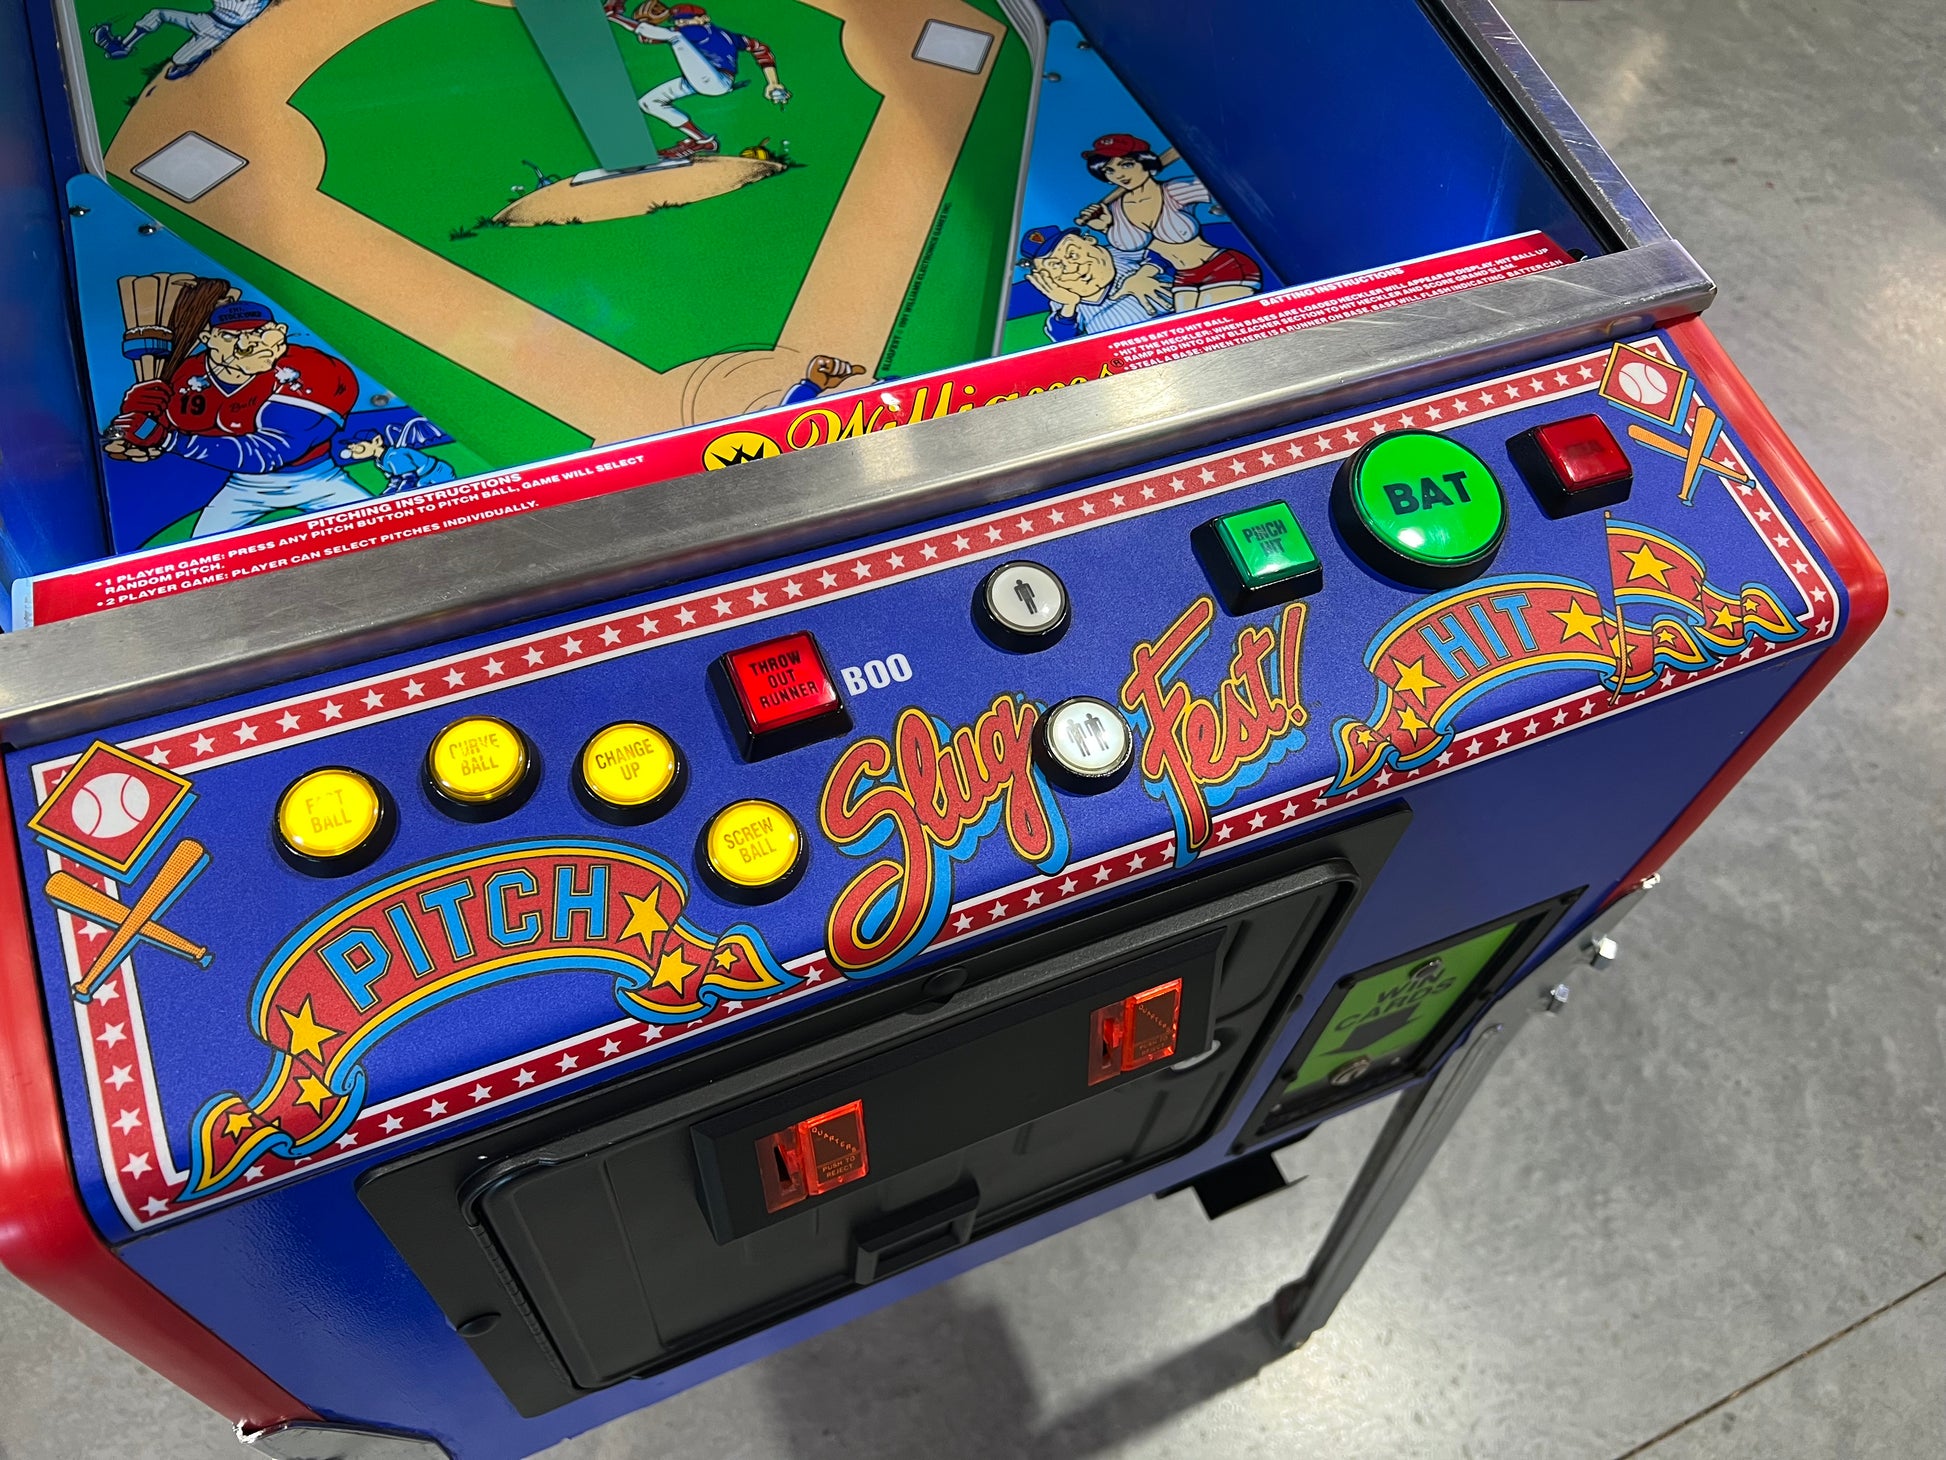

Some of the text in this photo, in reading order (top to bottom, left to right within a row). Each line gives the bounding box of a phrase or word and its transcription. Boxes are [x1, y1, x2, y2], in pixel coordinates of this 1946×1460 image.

[1119, 347, 1138, 356] HIT
[1138, 341, 1159, 352] THE
[1160, 330, 1213, 348] HECKLER:
[1212, 323, 1244, 335] WHEN
[1244, 315, 1277, 329] BASES
[1277, 309, 1298, 319] ARE
[1298, 299, 1338, 314] LOADED
[1339, 289, 1383, 304] HECKLER
[1383, 284, 1407, 294] WILL
[1407, 274, 1445, 288] APPEAR
[1444, 271, 1456, 281] IN
[1495, 257, 1512, 267] HIT
[1512, 251, 1536, 263] BALL
[1535, 247, 1549, 256] UP
[1259, 267, 1405, 307] BATTING INSTRUCTIONS
[1124, 351, 1155, 363] RAMP
[1156, 346, 1179, 356] AND
[1179, 339, 1205, 350] INTO
[1205, 334, 1227, 345] ANY
[1227, 320, 1279, 340] BLEACHER
[1278, 311, 1319, 327] SECTION
[1321, 306, 1338, 315] TO
[1339, 301, 1357, 310] HIT
[1356, 290, 1400, 305] HECKLER
[1400, 286, 1424, 296] AND
[1423, 278, 1456, 291] SCORE
[1456, 270, 1488, 284] GRAND
[1129, 357, 1164, 370] STEAL
[1203, 340, 1235, 353] WHEN
[1234, 332, 1268, 347] THERE
[1287, 316, 1328, 333] RUNNER
[1329, 313, 1344, 322] ON
[1372, 299, 1399, 312] BASE
[1399, 294, 1421, 305] WILL
[1420, 287, 1451, 301] FLASH
[1450, 273, 1504, 293] INDICATING
[1506, 262, 1544, 279] BATTER
[1543, 259, 1563, 270] CAN
[1112, 335, 1148, 350] PRESS
[1148, 330, 1169, 341] BAT
[1170, 326, 1185, 335] TO
[1185, 323, 1203, 333] HIT
[180, 394, 206, 416] 19
[307, 473, 523, 530] PITCHING INSTRUCTIONS
[1383, 471, 1472, 515] BAT
[104, 455, 645, 587] 1 PLAYER GAME: PRESS ANY PITCH BUTTON TO PITCH BALL, GAME WILL SELECT
[1242, 519, 1287, 543] PINCH
[106, 500, 540, 606] 2 PLAYER GAME: PLAYER CAN SELECT PITCHES INDIVIDUALLY.
[1259, 537, 1285, 555] HIT
[104, 562, 225, 595] RANDOM PITCH.
[1418, 593, 1540, 682] HIT
[748, 650, 801, 677] THROW
[840, 653, 914, 697] BOO
[759, 681, 819, 710] RUNNER
[767, 671, 797, 689] OUT
[460, 754, 499, 776] BALL
[595, 738, 655, 770] CHANGE
[620, 762, 641, 782] UP
[820, 597, 1308, 972] Slug Fest!
[305, 788, 344, 815] FT
[311, 808, 352, 835] BALL
[723, 816, 774, 850] SCREW
[739, 838, 777, 865] BALL
[317, 863, 610, 1014] PITCH
[1376, 967, 1447, 1003] WIN
[1333, 976, 1457, 1032] CARDS
[811, 1126, 857, 1153] QUARTERS
[822, 1155, 856, 1173] PUSH TO
[826, 1163, 854, 1178] REJECT
